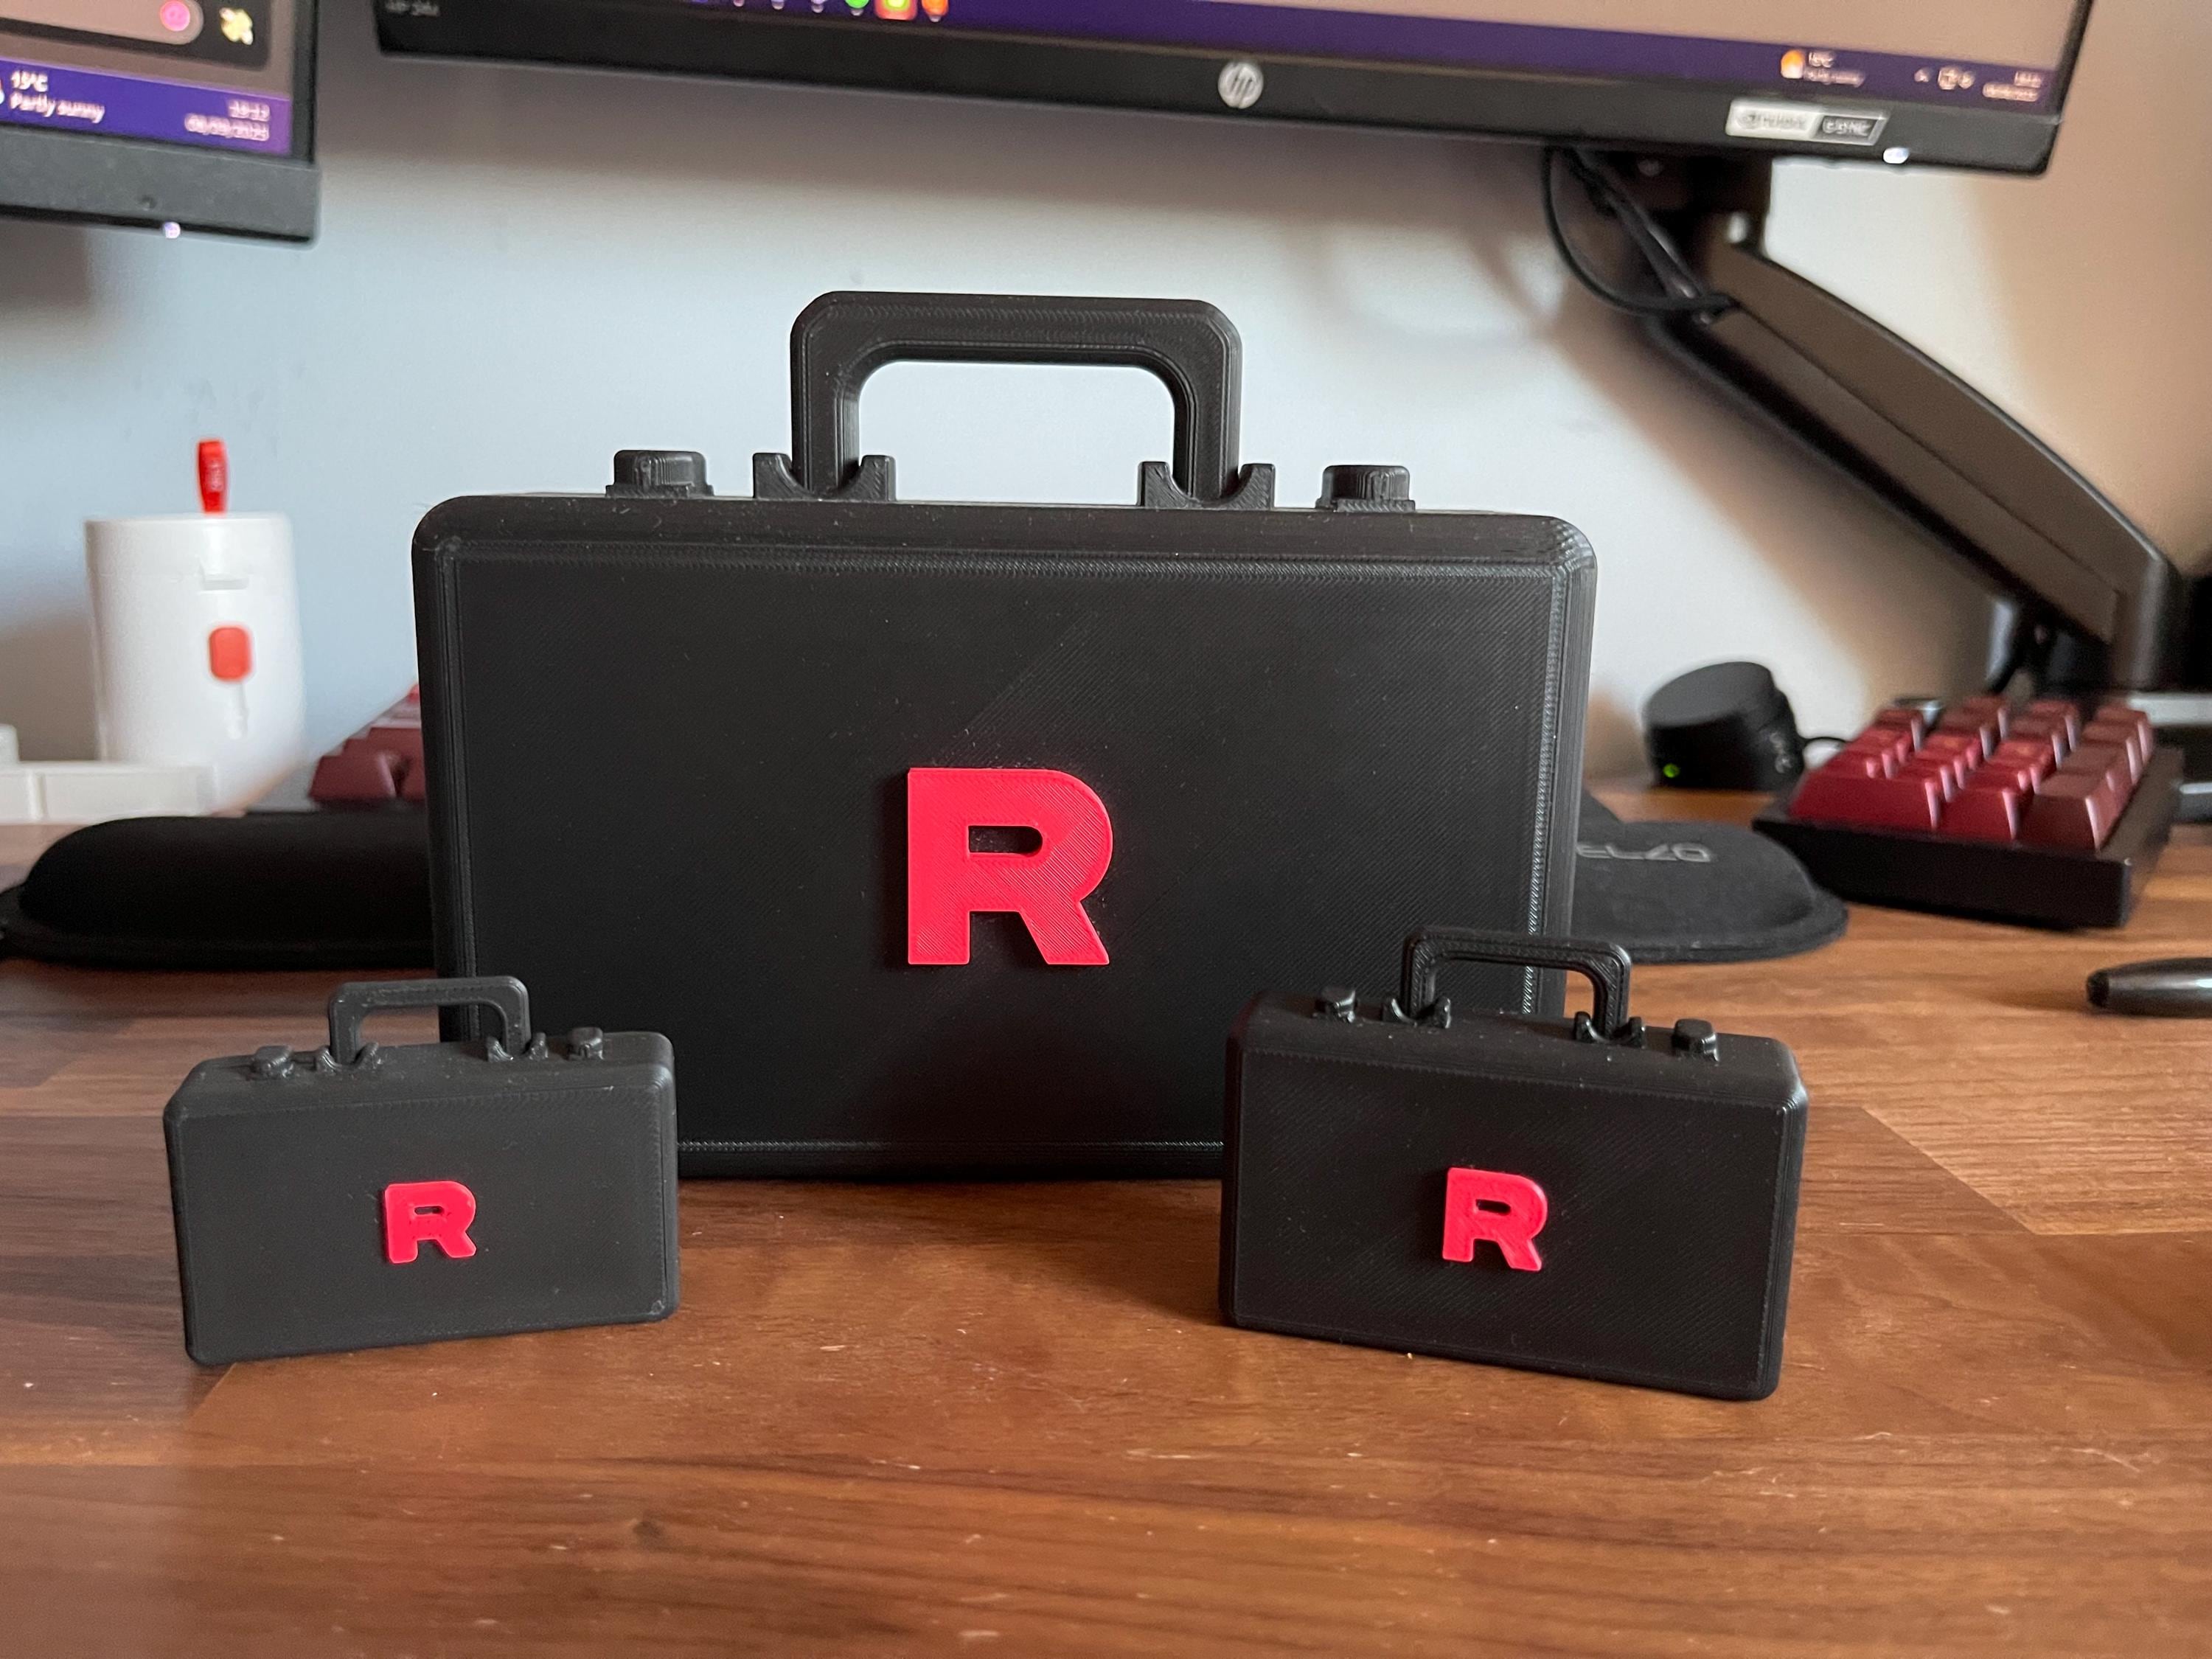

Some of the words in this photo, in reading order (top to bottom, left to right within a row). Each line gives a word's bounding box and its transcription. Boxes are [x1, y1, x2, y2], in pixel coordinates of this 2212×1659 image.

[908, 767, 1113, 965] R
[384, 1180, 477, 1264] R
[1442, 1166, 1548, 1272] R
